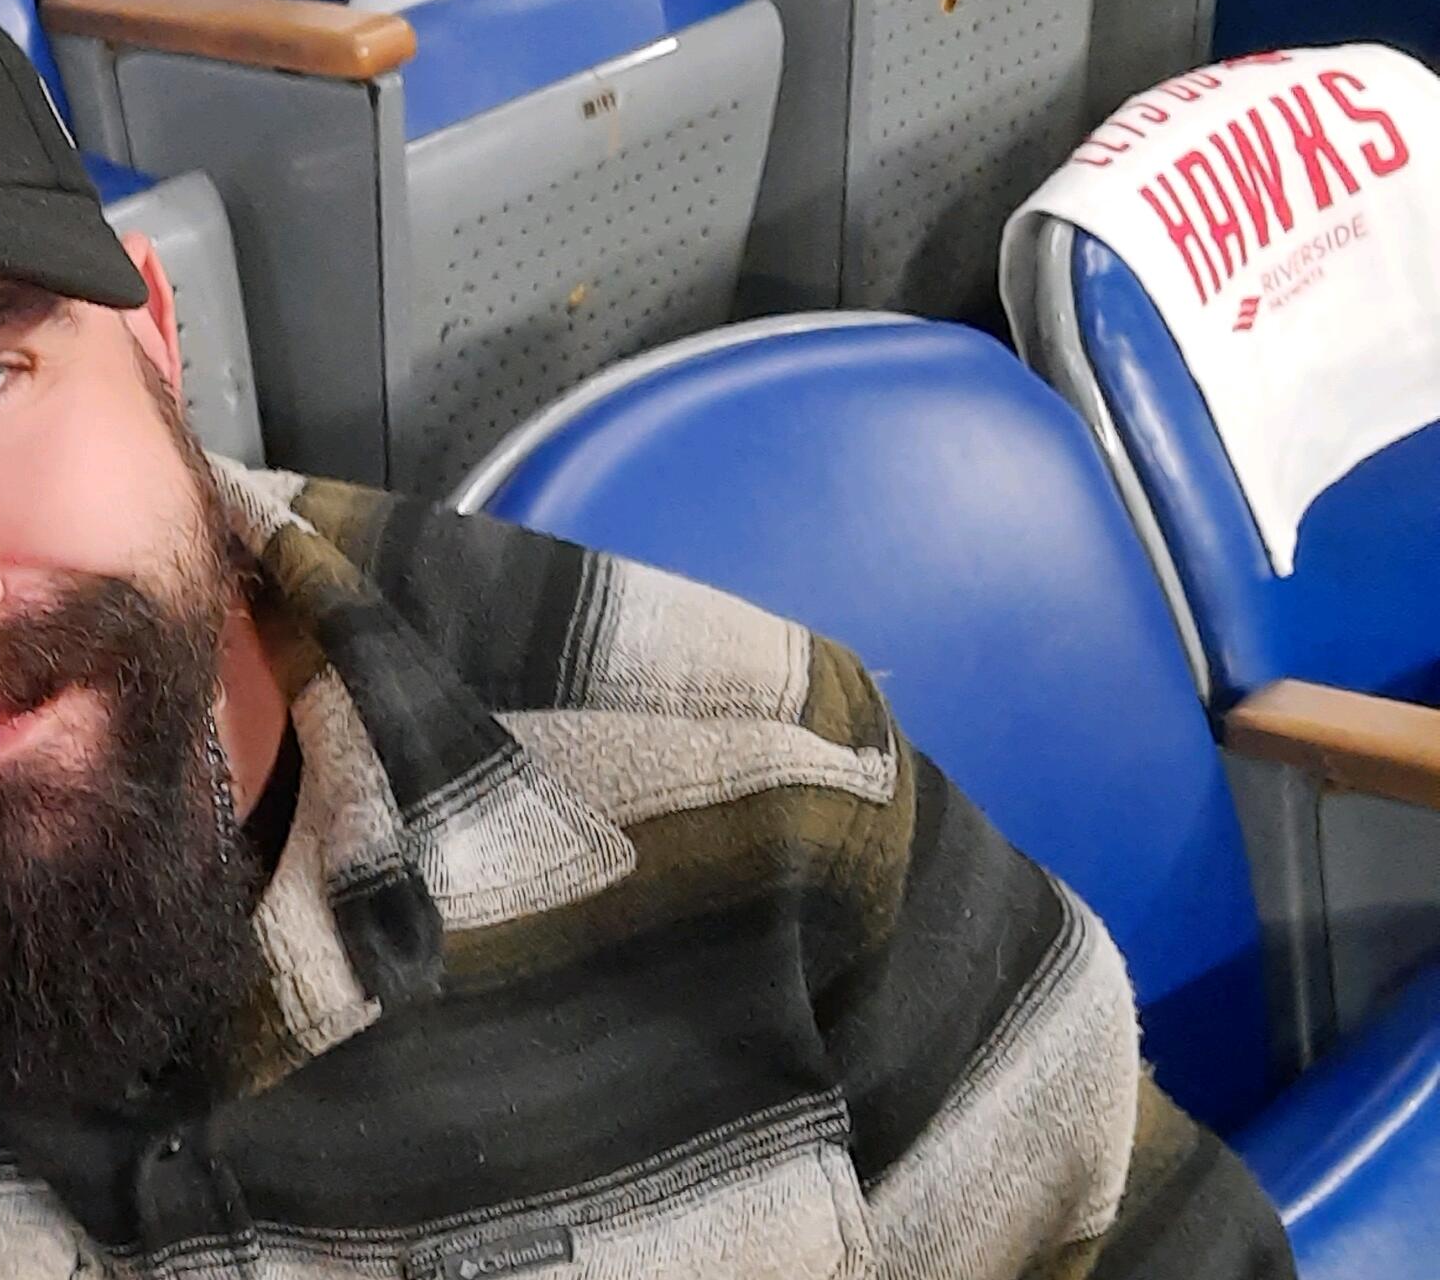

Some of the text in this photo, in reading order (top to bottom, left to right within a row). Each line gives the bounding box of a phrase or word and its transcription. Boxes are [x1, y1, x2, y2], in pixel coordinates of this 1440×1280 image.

[1138, 70, 1410, 306] HAWKS
[1262, 212, 1370, 292] RIVERSIDE
[479, 1238, 564, 1273] Columbia
